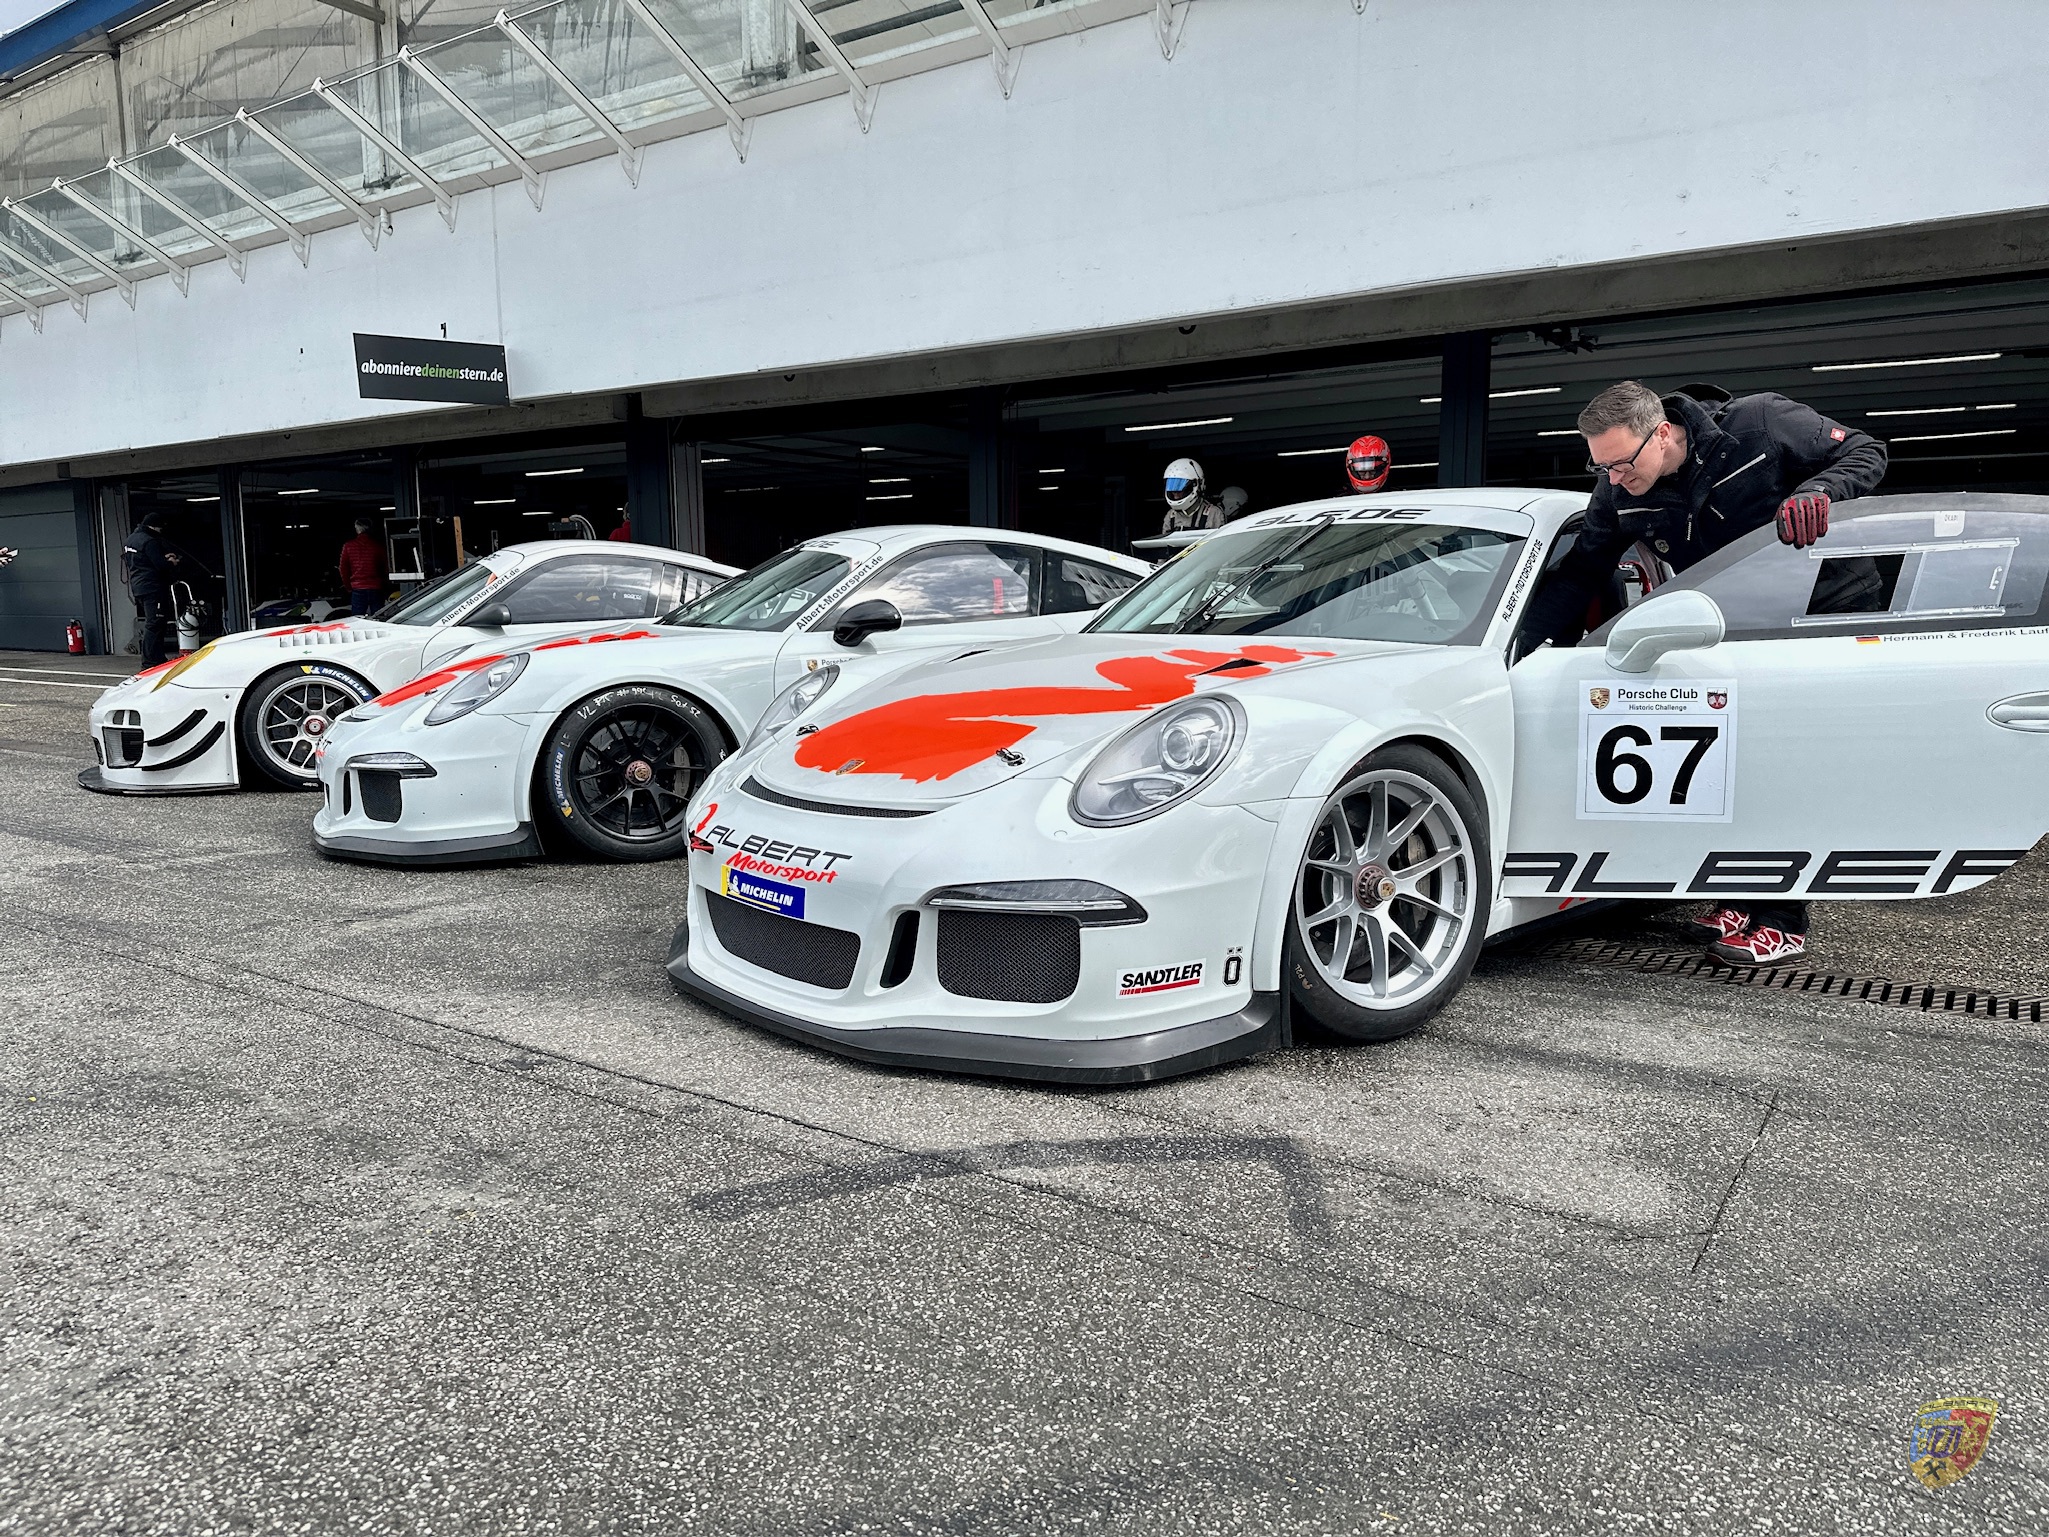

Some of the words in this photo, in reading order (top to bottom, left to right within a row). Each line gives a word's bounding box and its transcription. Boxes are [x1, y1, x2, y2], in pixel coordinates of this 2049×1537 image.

[361, 359, 504, 382] abonnieredeinenstern.de
[441, 567, 521, 625] Albert-Motorsport.de
[796, 555, 884, 631] Albert-Motorsport.de
[1883, 633, 1943, 642] Hermann
[1961, 629, 2017, 639] Frederik
[321, 667, 370, 698] MICHELIN
[1617, 688, 1667, 699] Porsche
[1670, 688, 1698, 699] Club
[1655, 704, 1687, 712] Challenge
[554, 751, 564, 801] MICHELIN
[1595, 724, 1719, 805] 67
[705, 825, 853, 870] ALBERT
[725, 851, 839, 884] Motorsport
[740, 882, 794, 907] MICHELIN
[1121, 963, 1203, 988] SANDTLER
